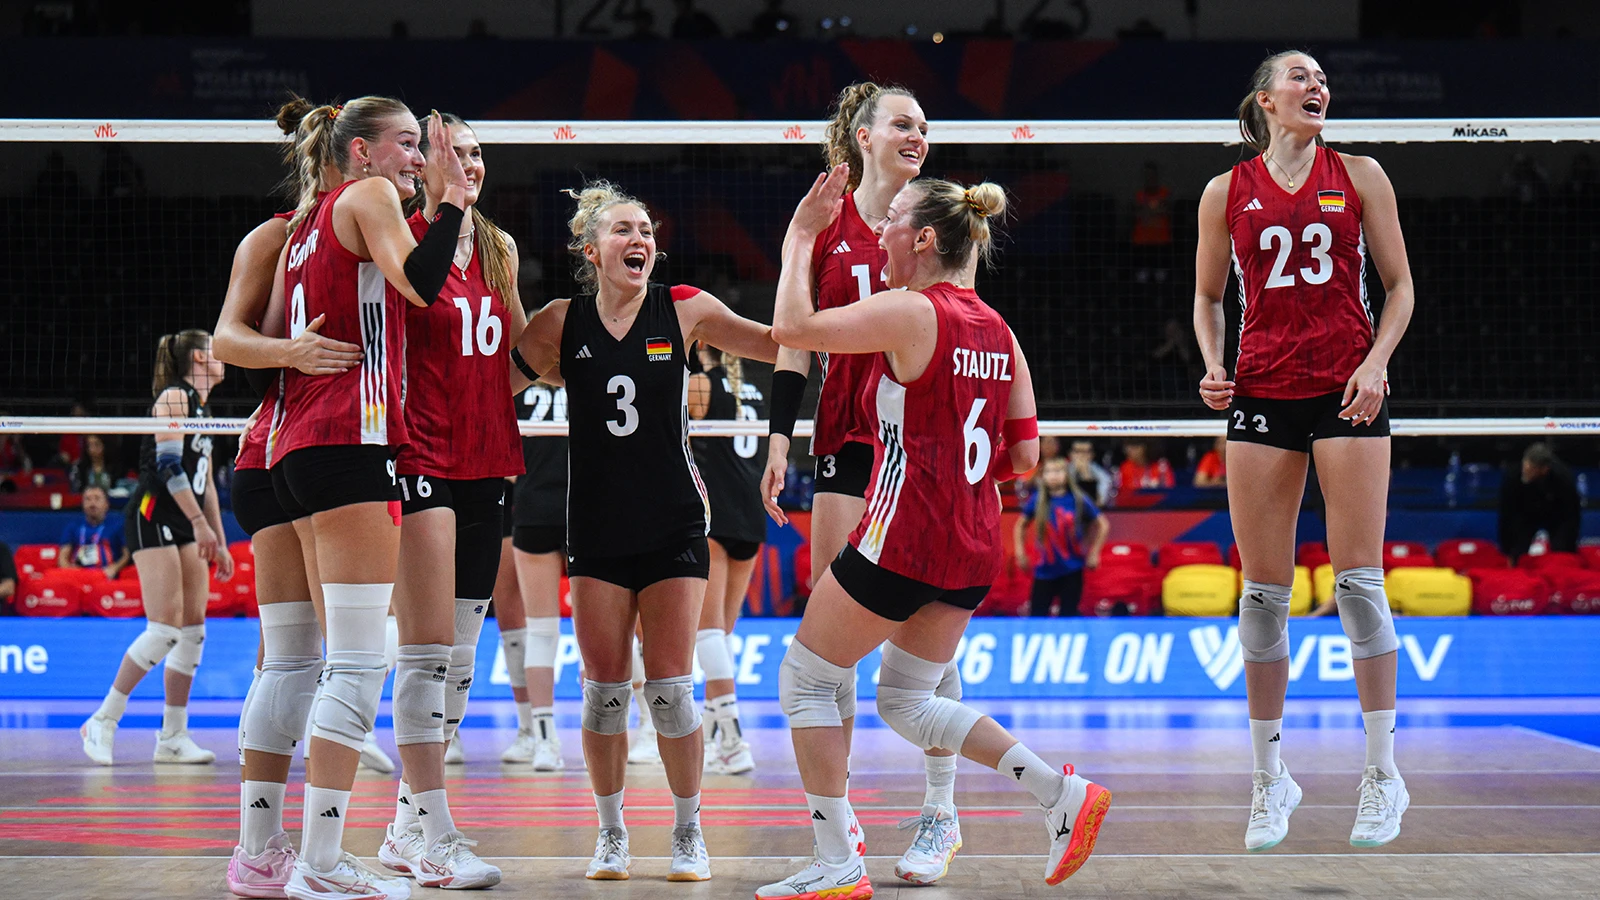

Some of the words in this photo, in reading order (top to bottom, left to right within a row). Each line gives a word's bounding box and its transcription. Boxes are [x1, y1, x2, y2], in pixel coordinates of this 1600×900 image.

[1321, 205, 1345, 213] GERMANY
[1260, 223, 1333, 289] 23
[452, 296, 502, 356] 16
[953, 347, 1012, 381] STAUTZ
[606, 375, 639, 437] 3
[1233, 410, 1269, 433] 23
[963, 398, 991, 485] 6
[193, 456, 208, 495] 8
[386, 459, 396, 486] 9
[399, 475, 432, 501] 16
[1010, 633, 1088, 684] VNL
[1104, 633, 1174, 684] ON
